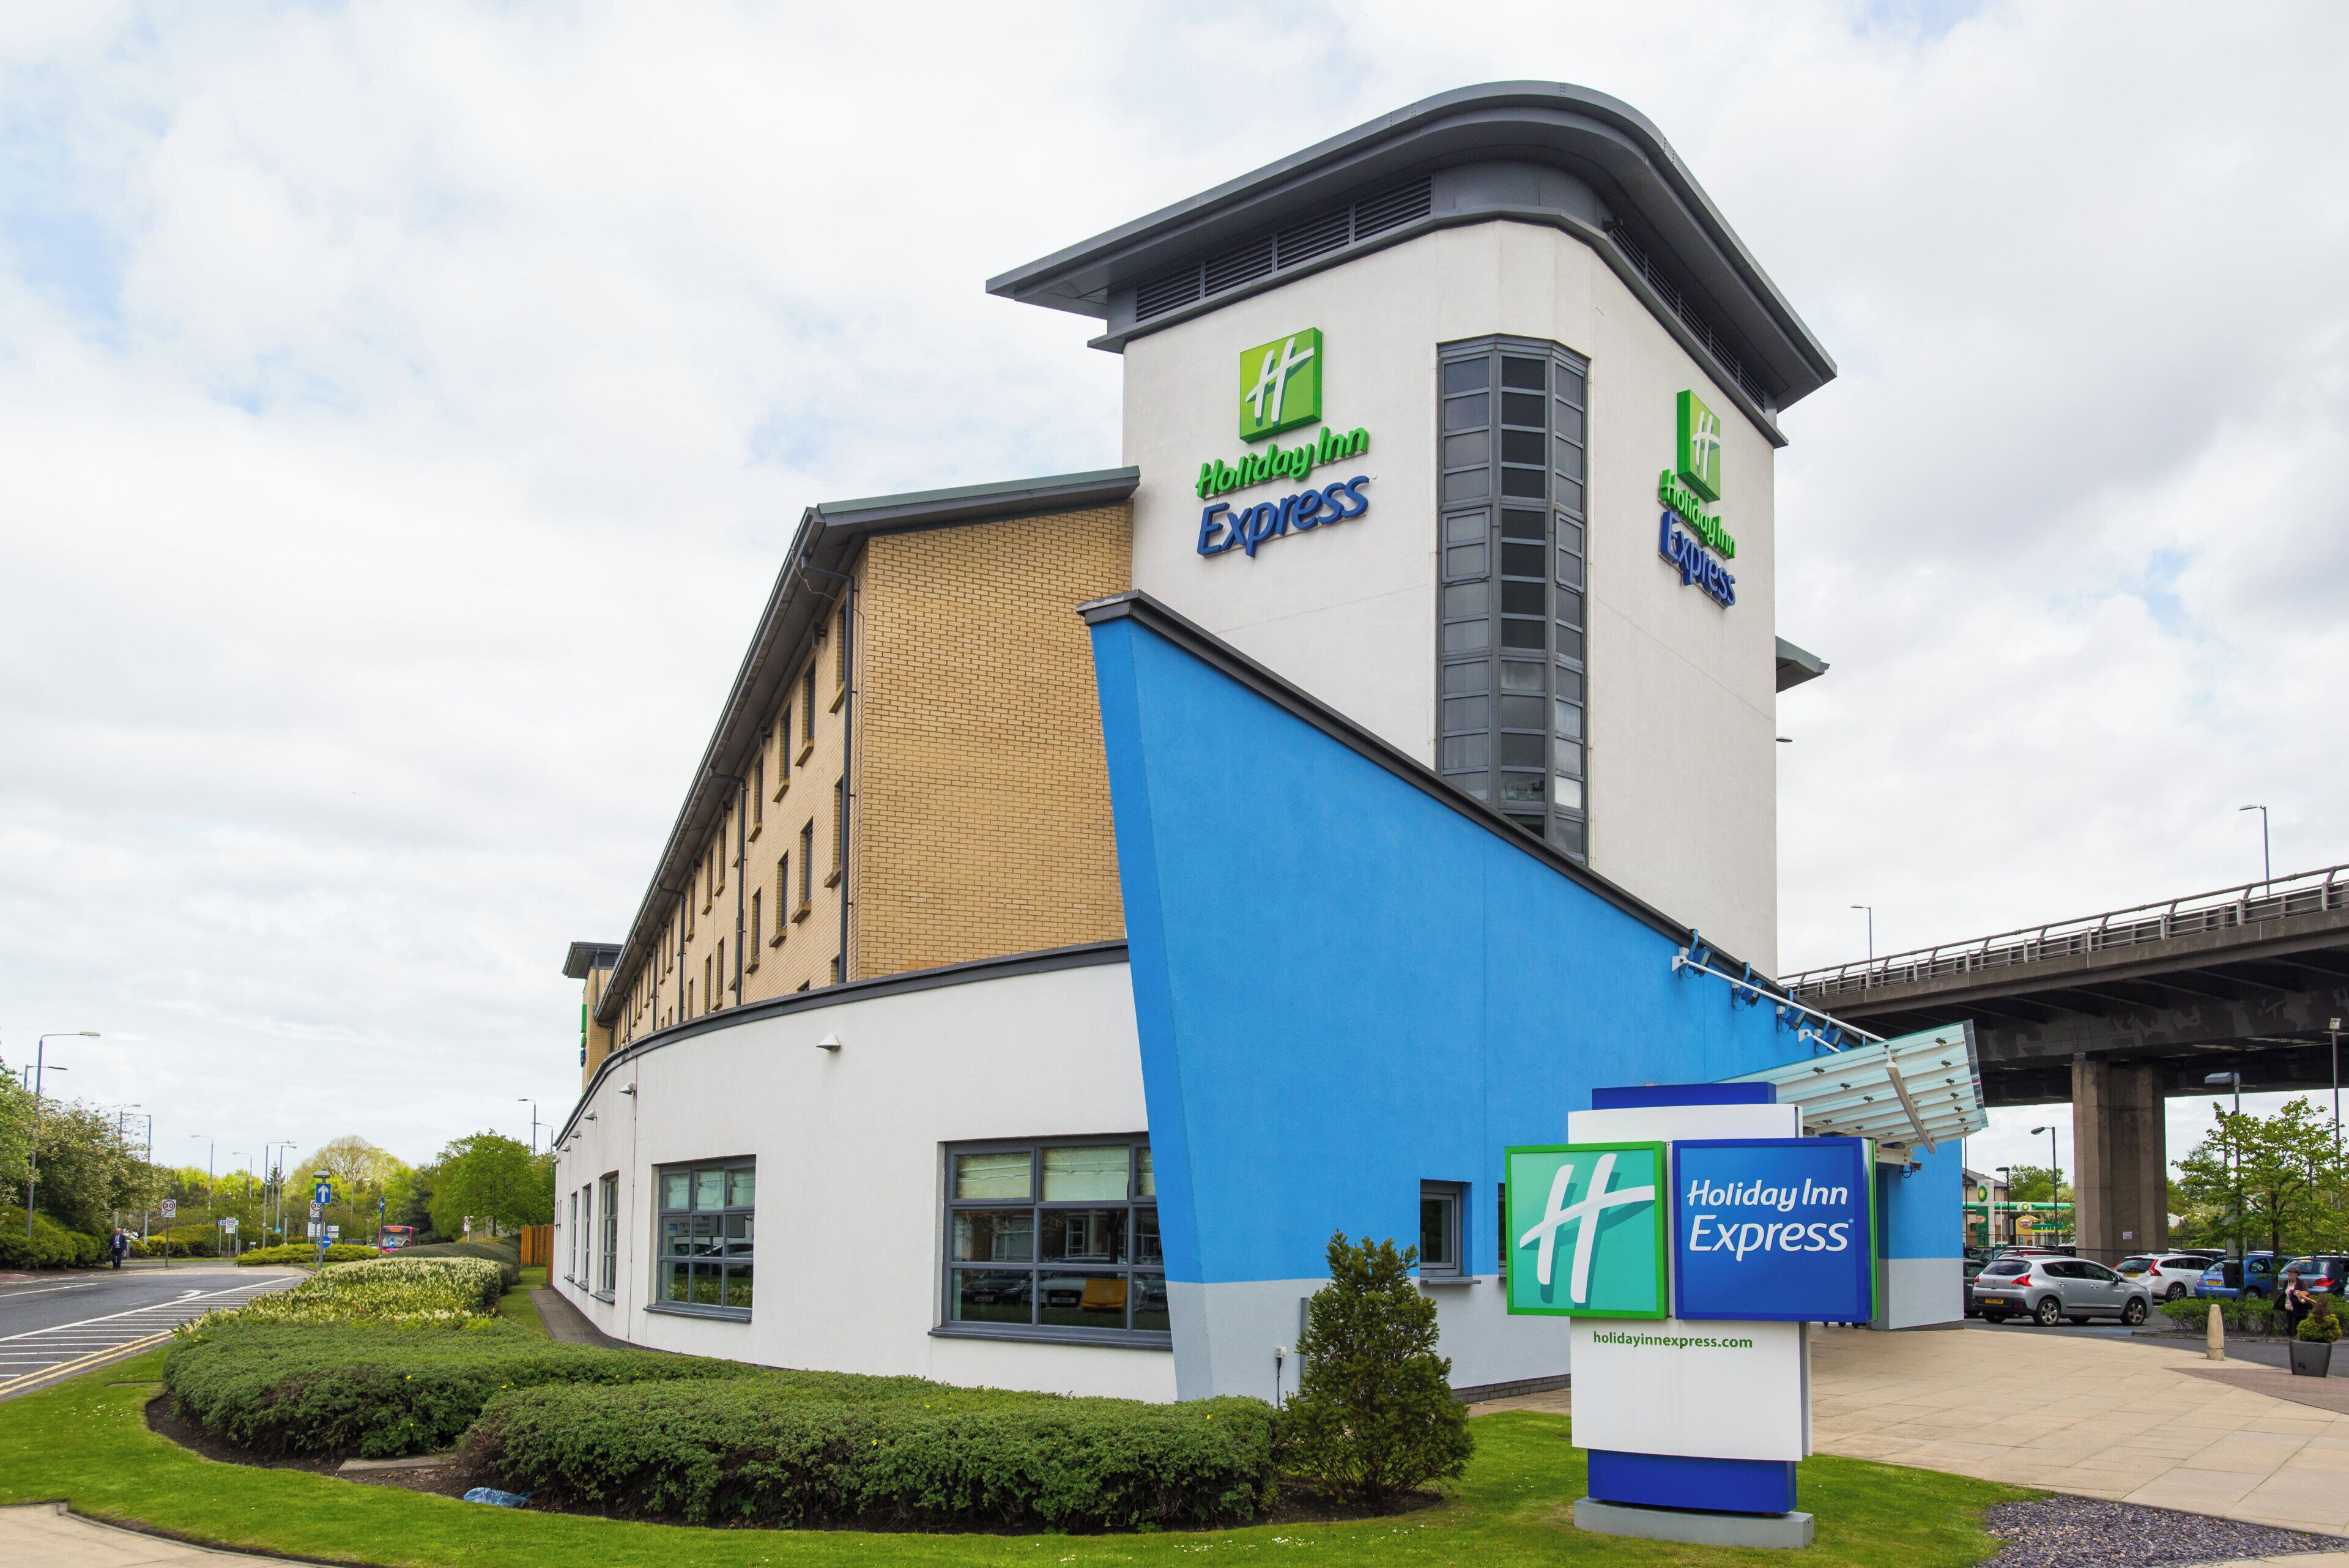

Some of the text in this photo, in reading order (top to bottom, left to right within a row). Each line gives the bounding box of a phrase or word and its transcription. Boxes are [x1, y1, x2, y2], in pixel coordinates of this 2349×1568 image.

[1195, 426, 1369, 499] Holiday Inn
[1197, 475, 1369, 557] Express
[1660, 469, 1736, 559] Holiday Inn
[1661, 511, 1735, 606] Express
[1687, 1178, 1847, 1212] Holiday Inn
[1690, 1214, 1849, 1261] Express
[1594, 1331, 1753, 1349] holidayinnexpress.com
